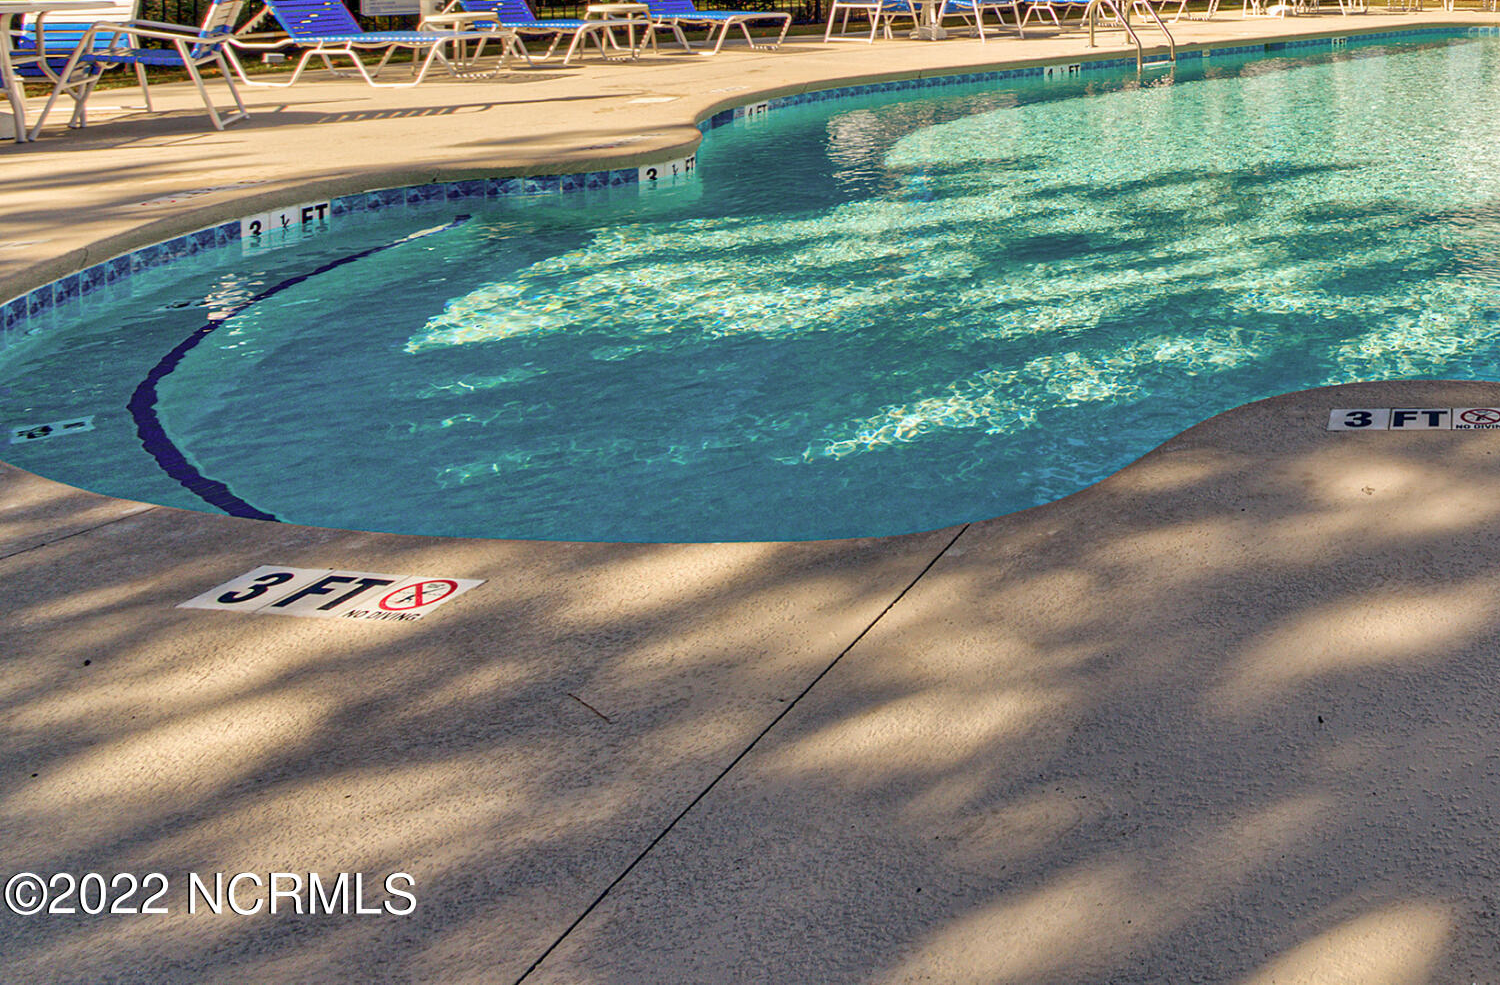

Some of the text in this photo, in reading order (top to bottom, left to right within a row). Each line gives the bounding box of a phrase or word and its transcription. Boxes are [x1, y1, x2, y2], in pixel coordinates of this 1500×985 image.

[1068, 64, 1080, 72] FT
[757, 104, 767, 113] FT
[302, 203, 328, 224] FT
[1344, 410, 1448, 427] 3 FT
[217, 572, 395, 610] 3 FT
[342, 609, 421, 621] NO DIVING
